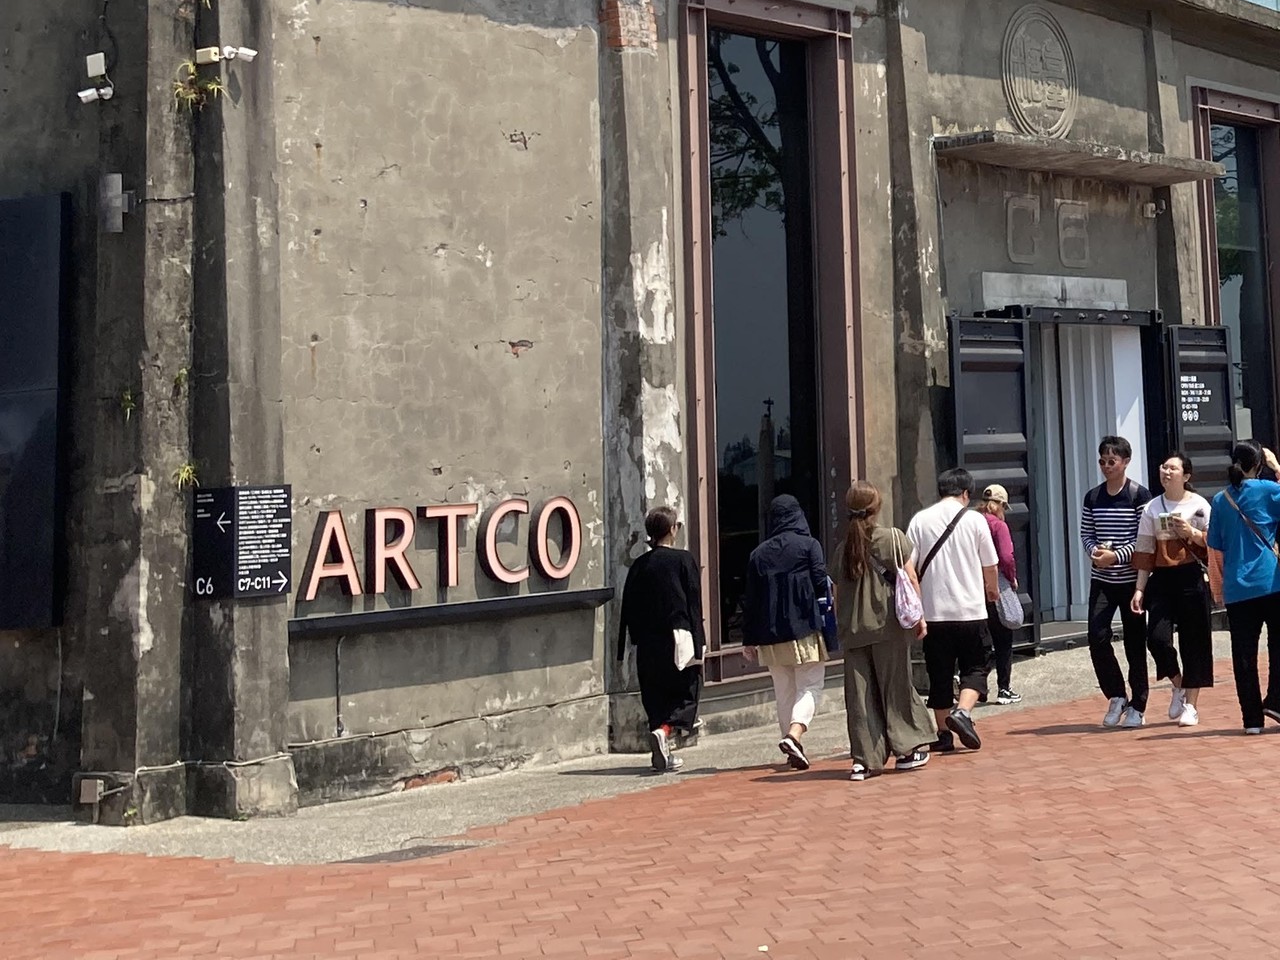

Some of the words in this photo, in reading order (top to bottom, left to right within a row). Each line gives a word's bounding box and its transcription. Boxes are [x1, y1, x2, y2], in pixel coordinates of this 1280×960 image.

[302, 496, 582, 601] ARTCO
[196, 577, 214, 595] C6
[238, 576, 271, 591] C7-C11
